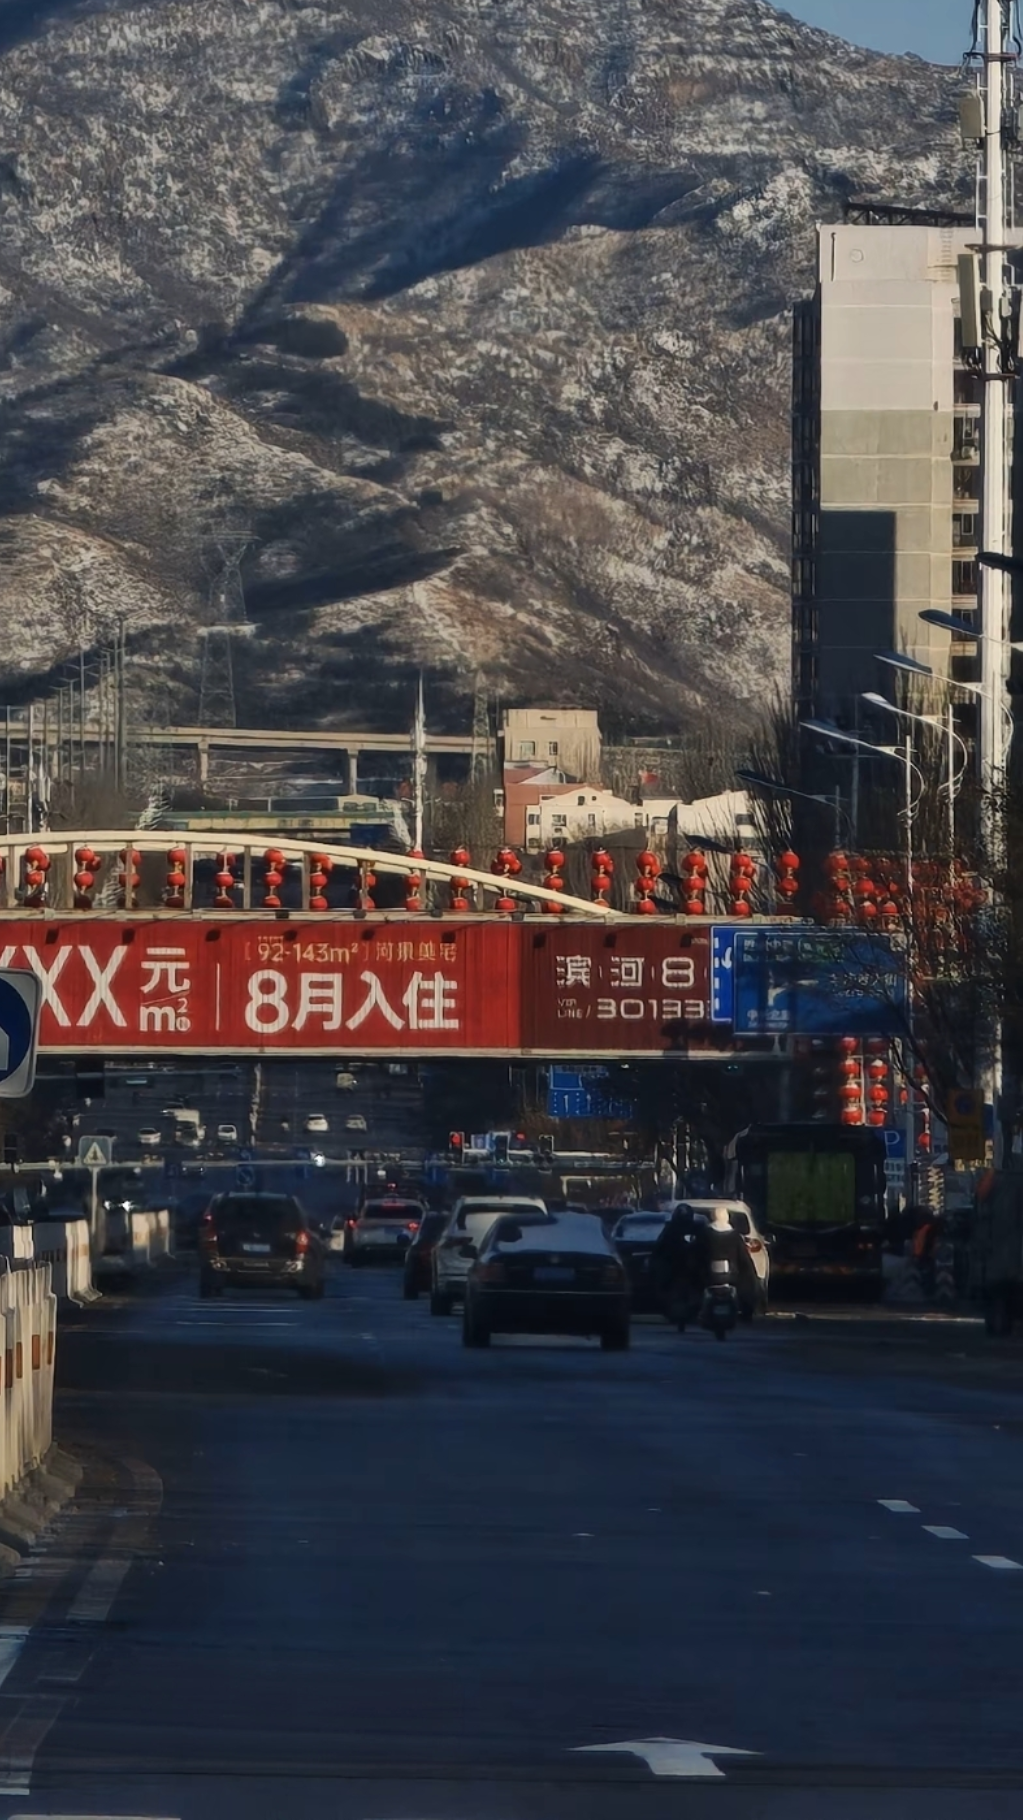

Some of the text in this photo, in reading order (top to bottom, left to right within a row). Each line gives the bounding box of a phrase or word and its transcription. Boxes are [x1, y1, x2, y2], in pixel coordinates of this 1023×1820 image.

[140, 947, 191, 993] 元
[244, 969, 459, 1033] 8月入住
